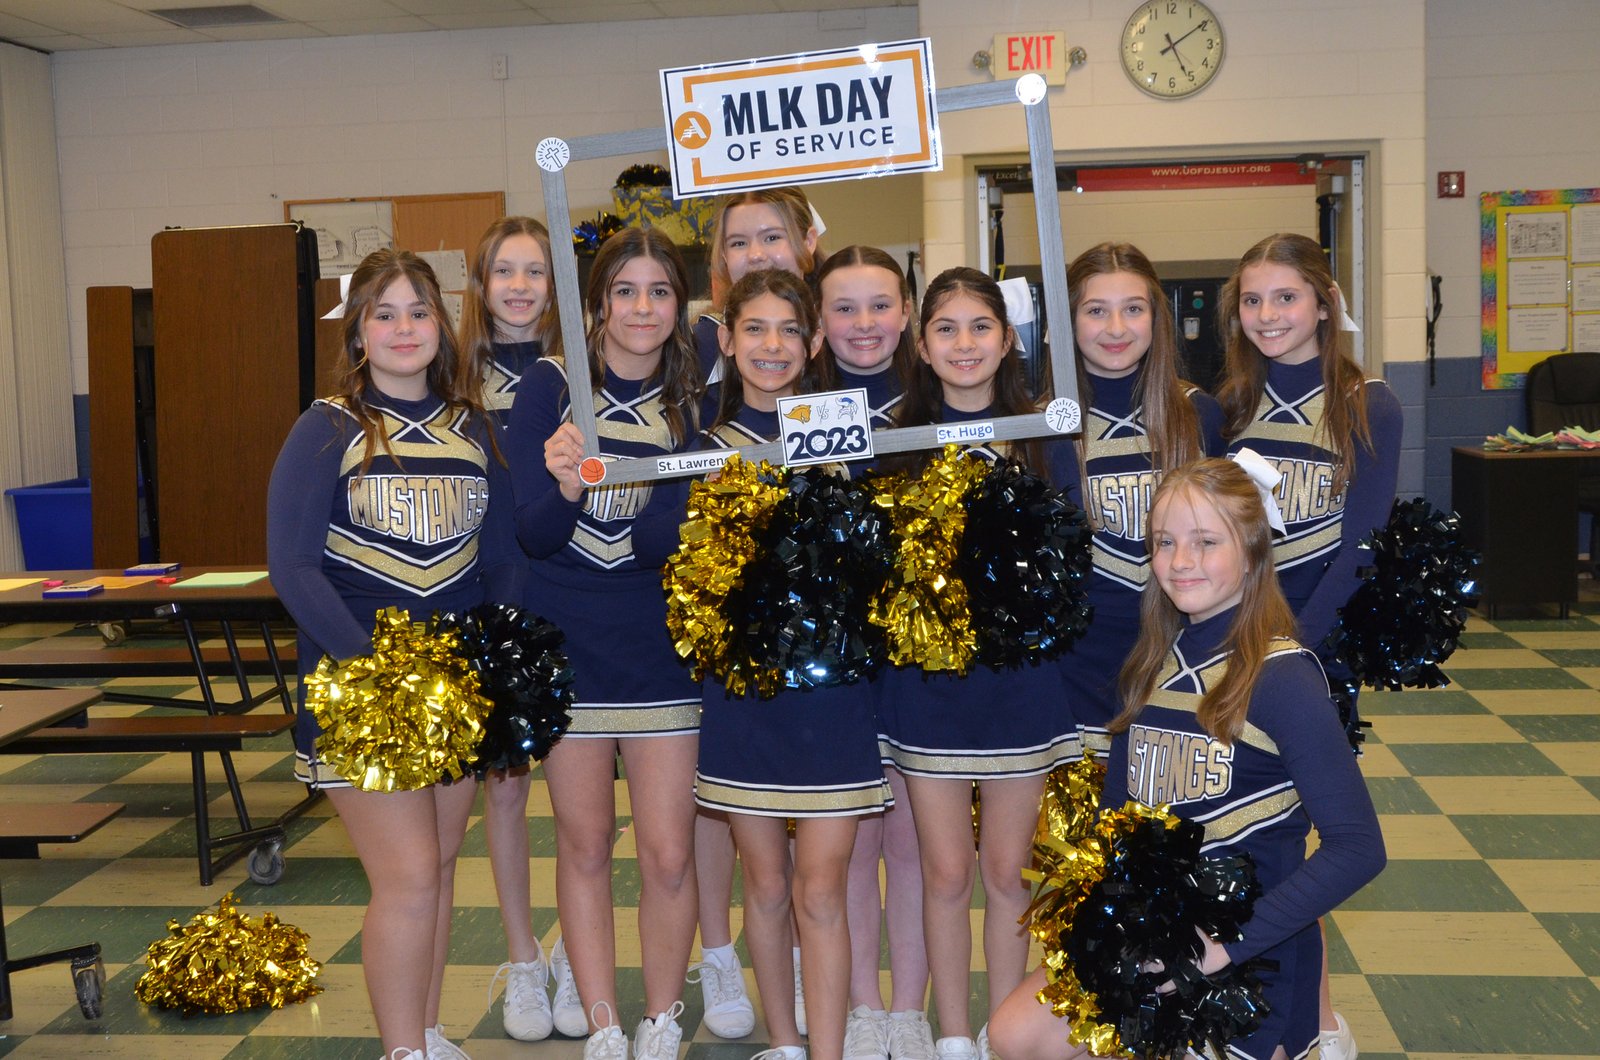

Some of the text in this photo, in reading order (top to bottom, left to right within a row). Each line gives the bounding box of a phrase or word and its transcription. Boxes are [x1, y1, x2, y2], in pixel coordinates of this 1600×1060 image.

[1149, 8, 1158, 20] 11
[1166, 3, 1177, 14] 12
[1201, 20, 1208, 32] 2
[1206, 39, 1214, 50] 3
[1008, 35, 1055, 71] EXIT
[1137, 60, 1144, 71] 8
[1201, 57, 1209, 68] 4
[1151, 72, 1158, 83] 7
[1187, 71, 1195, 82] 5
[1169, 77, 1176, 88] 6
[722, 75, 893, 137] MLK DAY
[727, 125, 894, 162] OF SERVICE
[1152, 165, 1271, 176] WWW.UOFDJESUIT.ORG
[938, 425, 993, 440] St. Hugo
[786, 424, 868, 461] 2023
[658, 461, 675, 472] St.
[348, 474, 489, 545] MUSTANGS
[1127, 724, 1235, 809] STANGS
